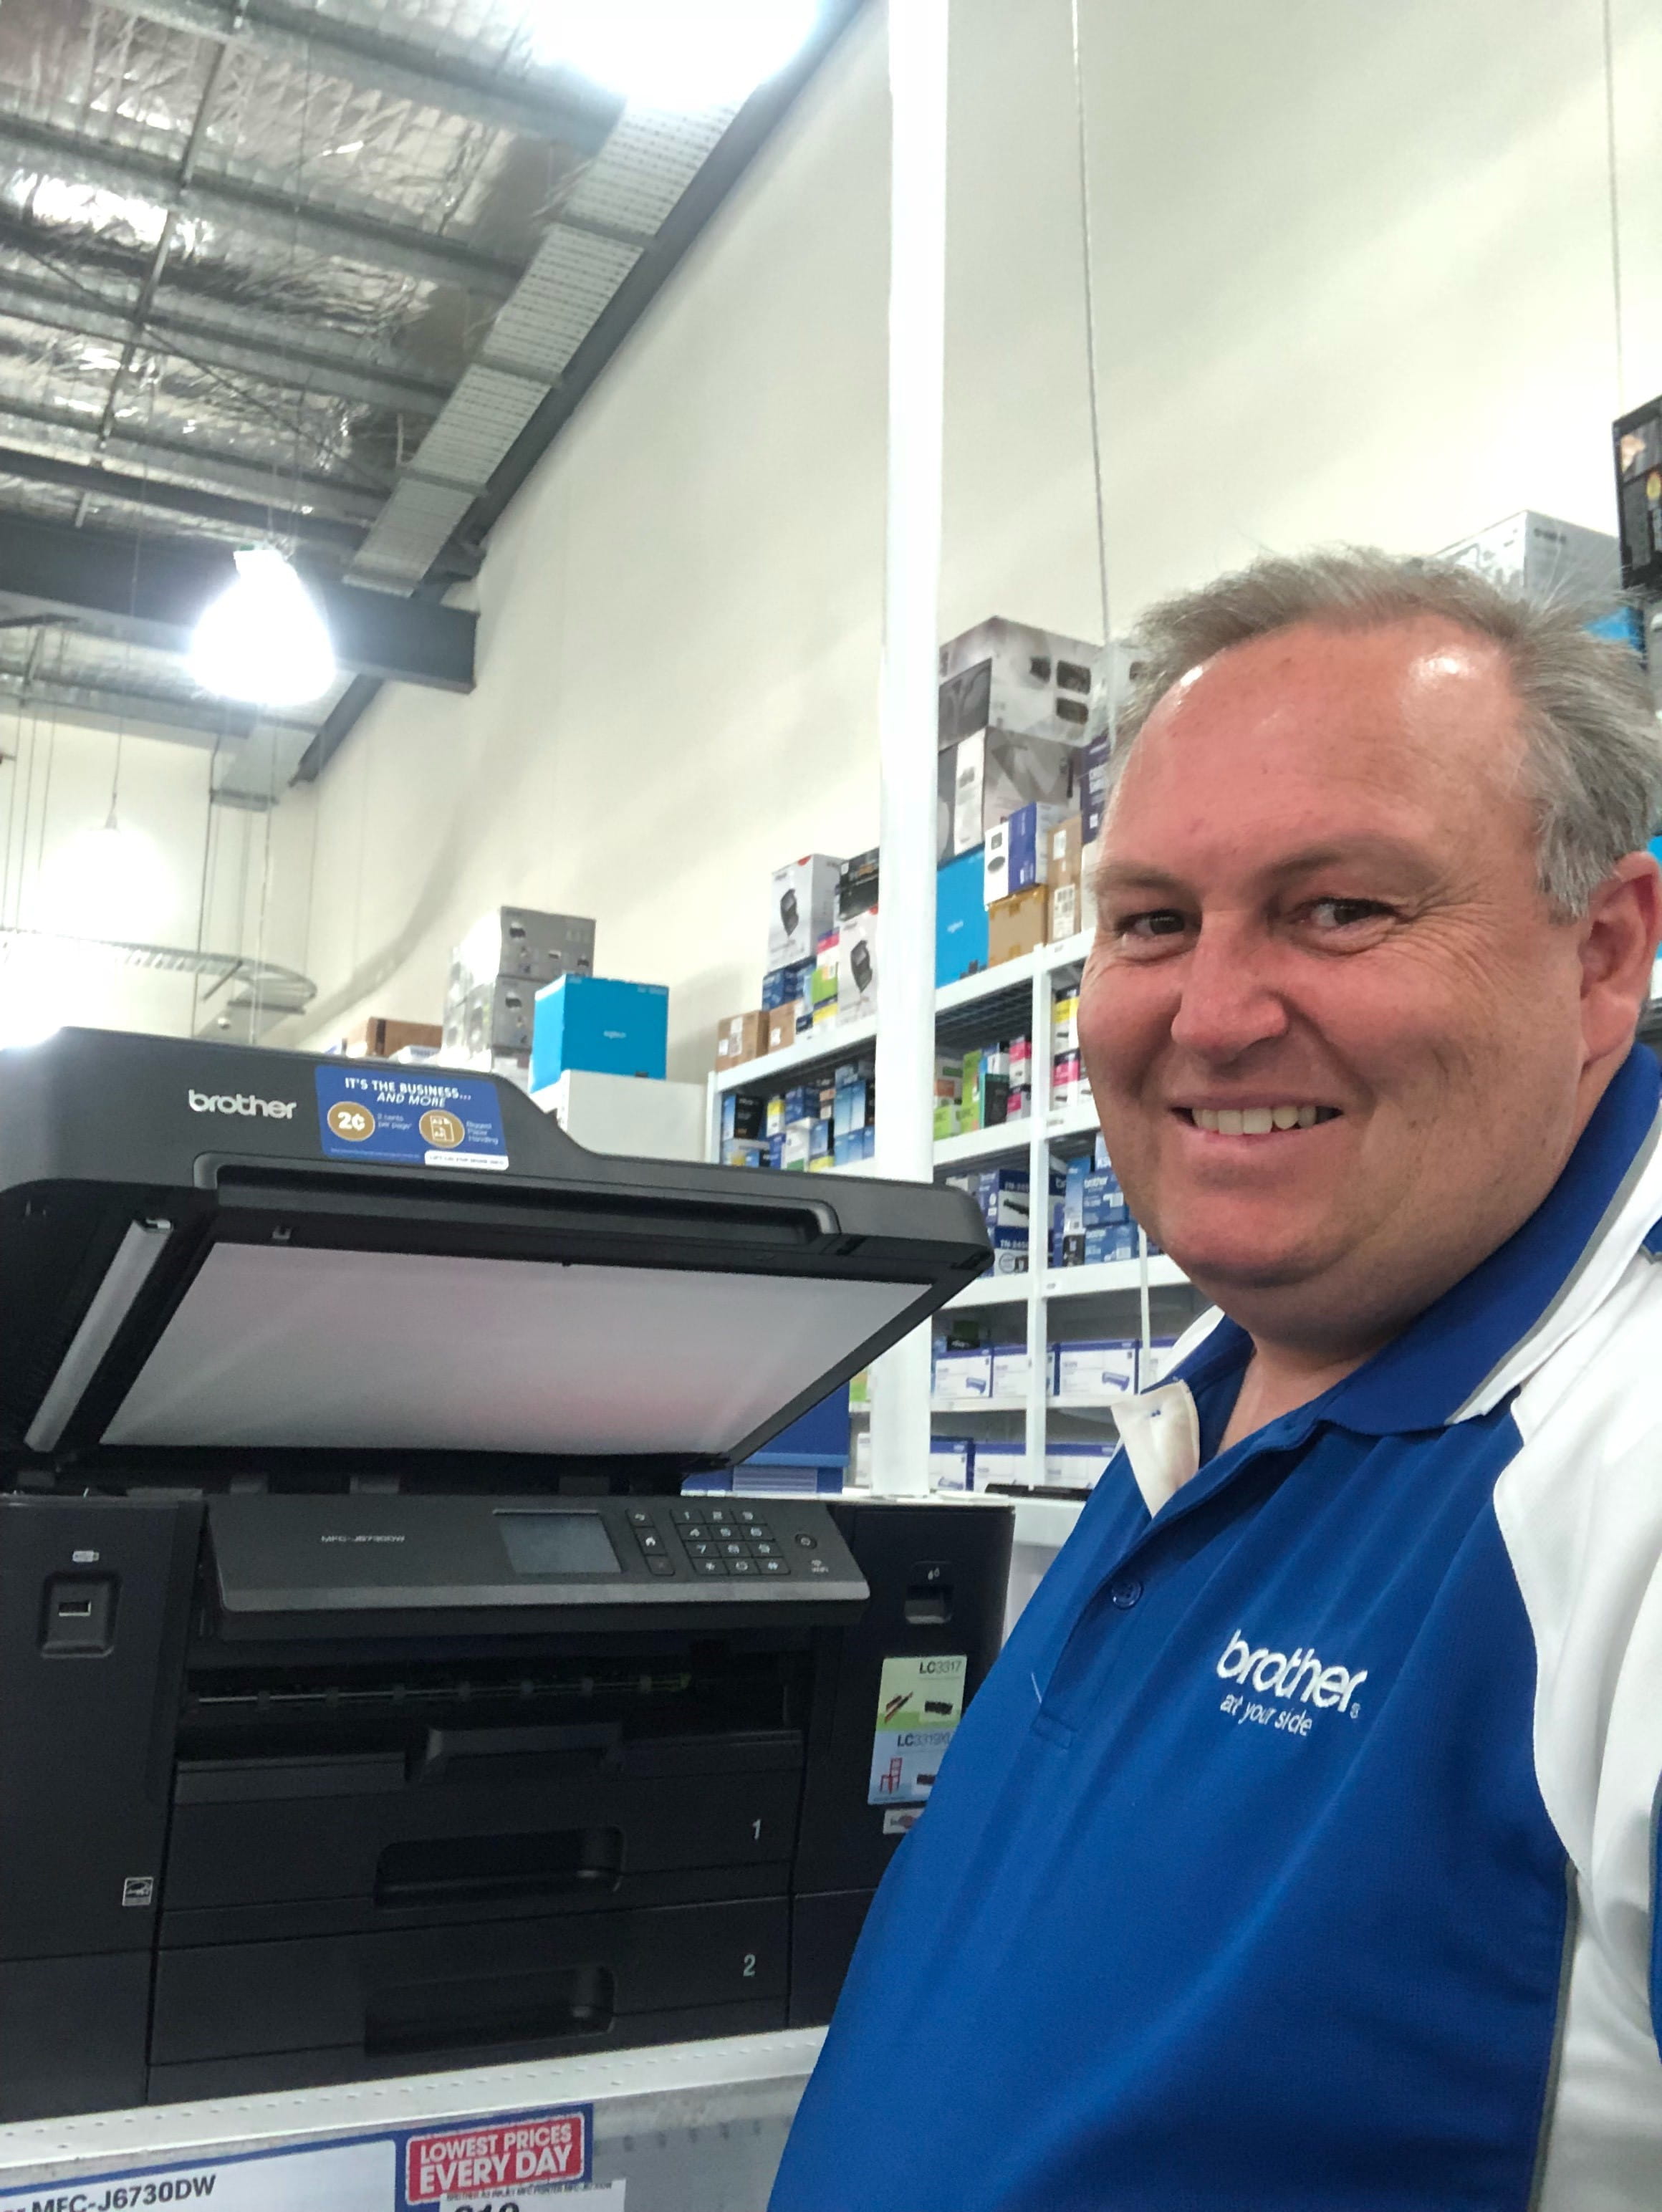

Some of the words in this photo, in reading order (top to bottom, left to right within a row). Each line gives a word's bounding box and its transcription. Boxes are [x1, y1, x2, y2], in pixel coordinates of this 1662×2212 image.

[345, 1077, 368, 1090] IT'S
[372, 1079, 395, 1092] THE
[377, 1092, 405, 1104] AND
[409, 1095, 446, 1107] MORE
[188, 1089, 297, 1119] brother
[1216, 1628, 1368, 1713] brother
[1220, 1693, 1244, 1716] at
[1238, 1701, 1277, 1725] your
[1274, 1707, 1313, 1736] side
[753, 1818, 762, 1840] 1
[743, 1953, 756, 1977] 2
[419, 2133, 499, 2165] LOWEST
[504, 2122, 572, 2150] PRICES
[419, 2152, 511, 2195] EVERY
[515, 2144, 572, 2180] DAY
